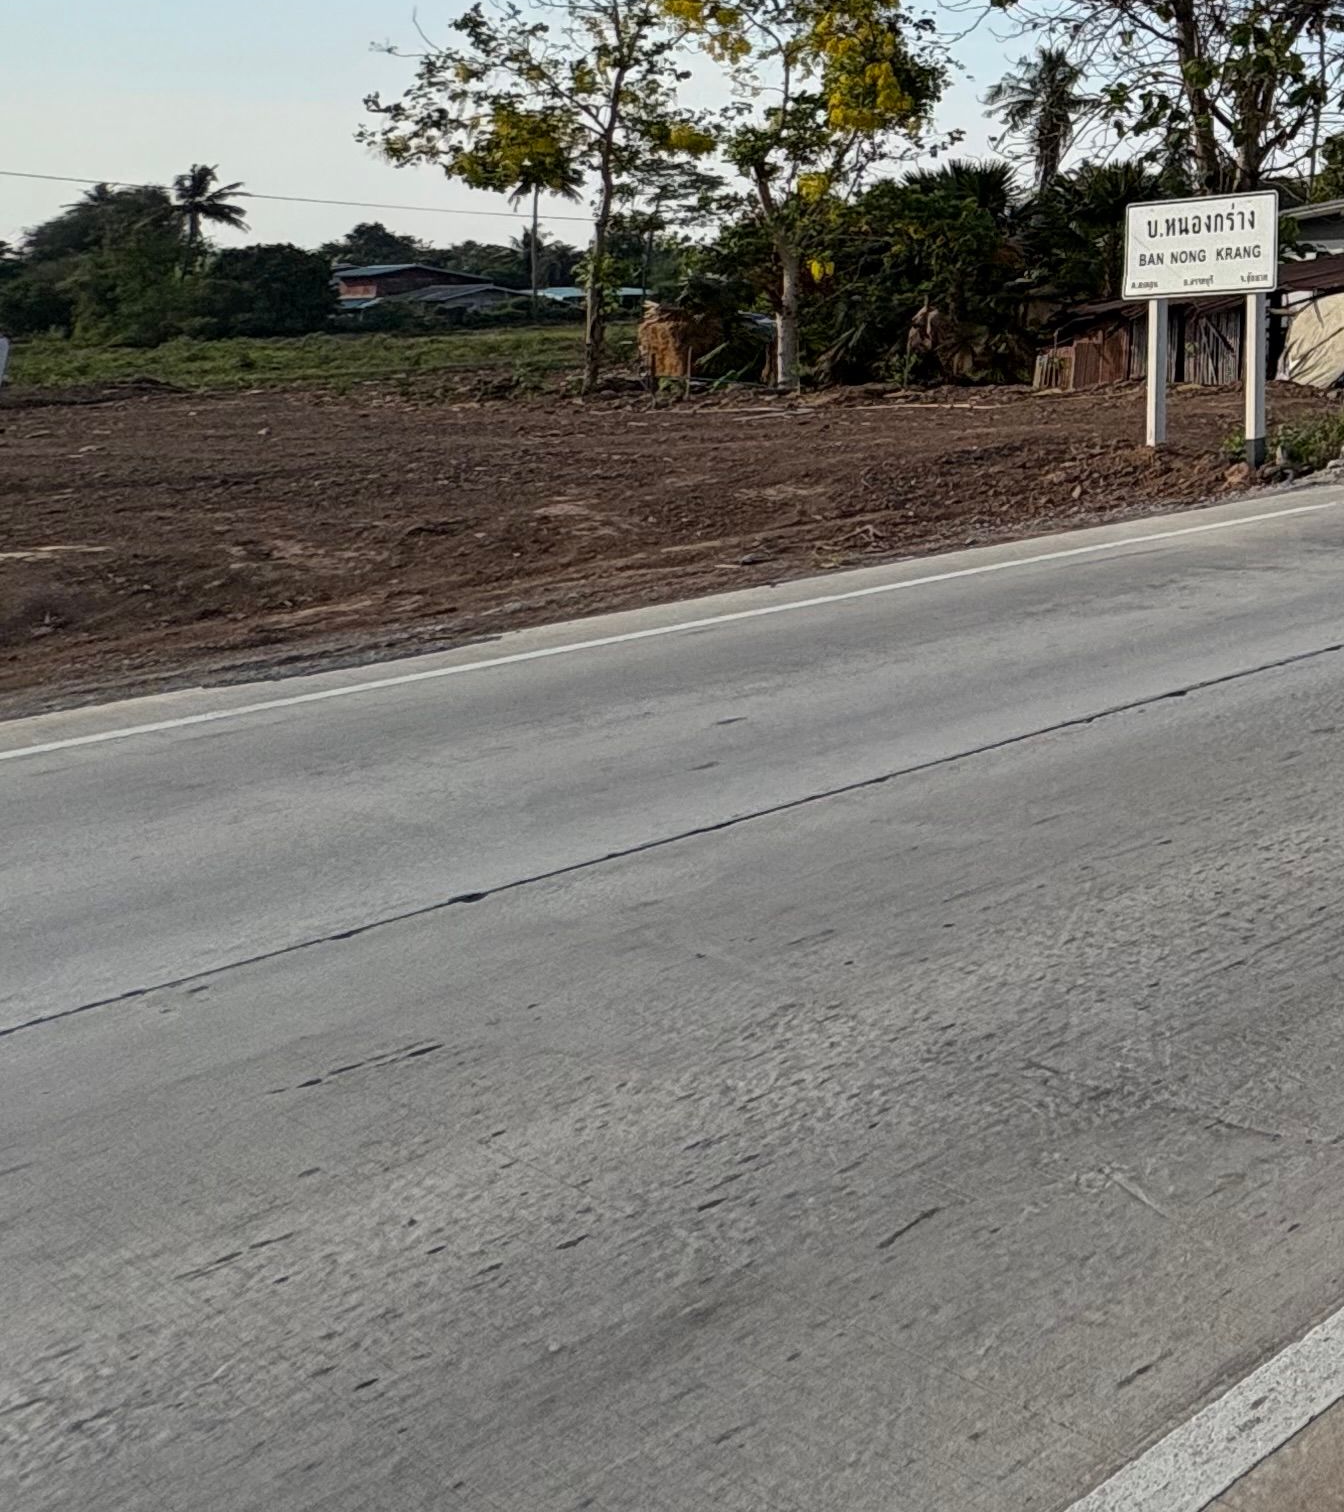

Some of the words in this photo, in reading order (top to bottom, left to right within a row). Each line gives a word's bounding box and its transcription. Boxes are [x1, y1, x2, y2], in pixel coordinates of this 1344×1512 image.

[1147, 202, 1256, 239] บ.หนองกร่าง
[1138, 252, 1164, 267] BAN
[1170, 249, 1207, 265] NONG
[1215, 244, 1262, 261] KRANG
